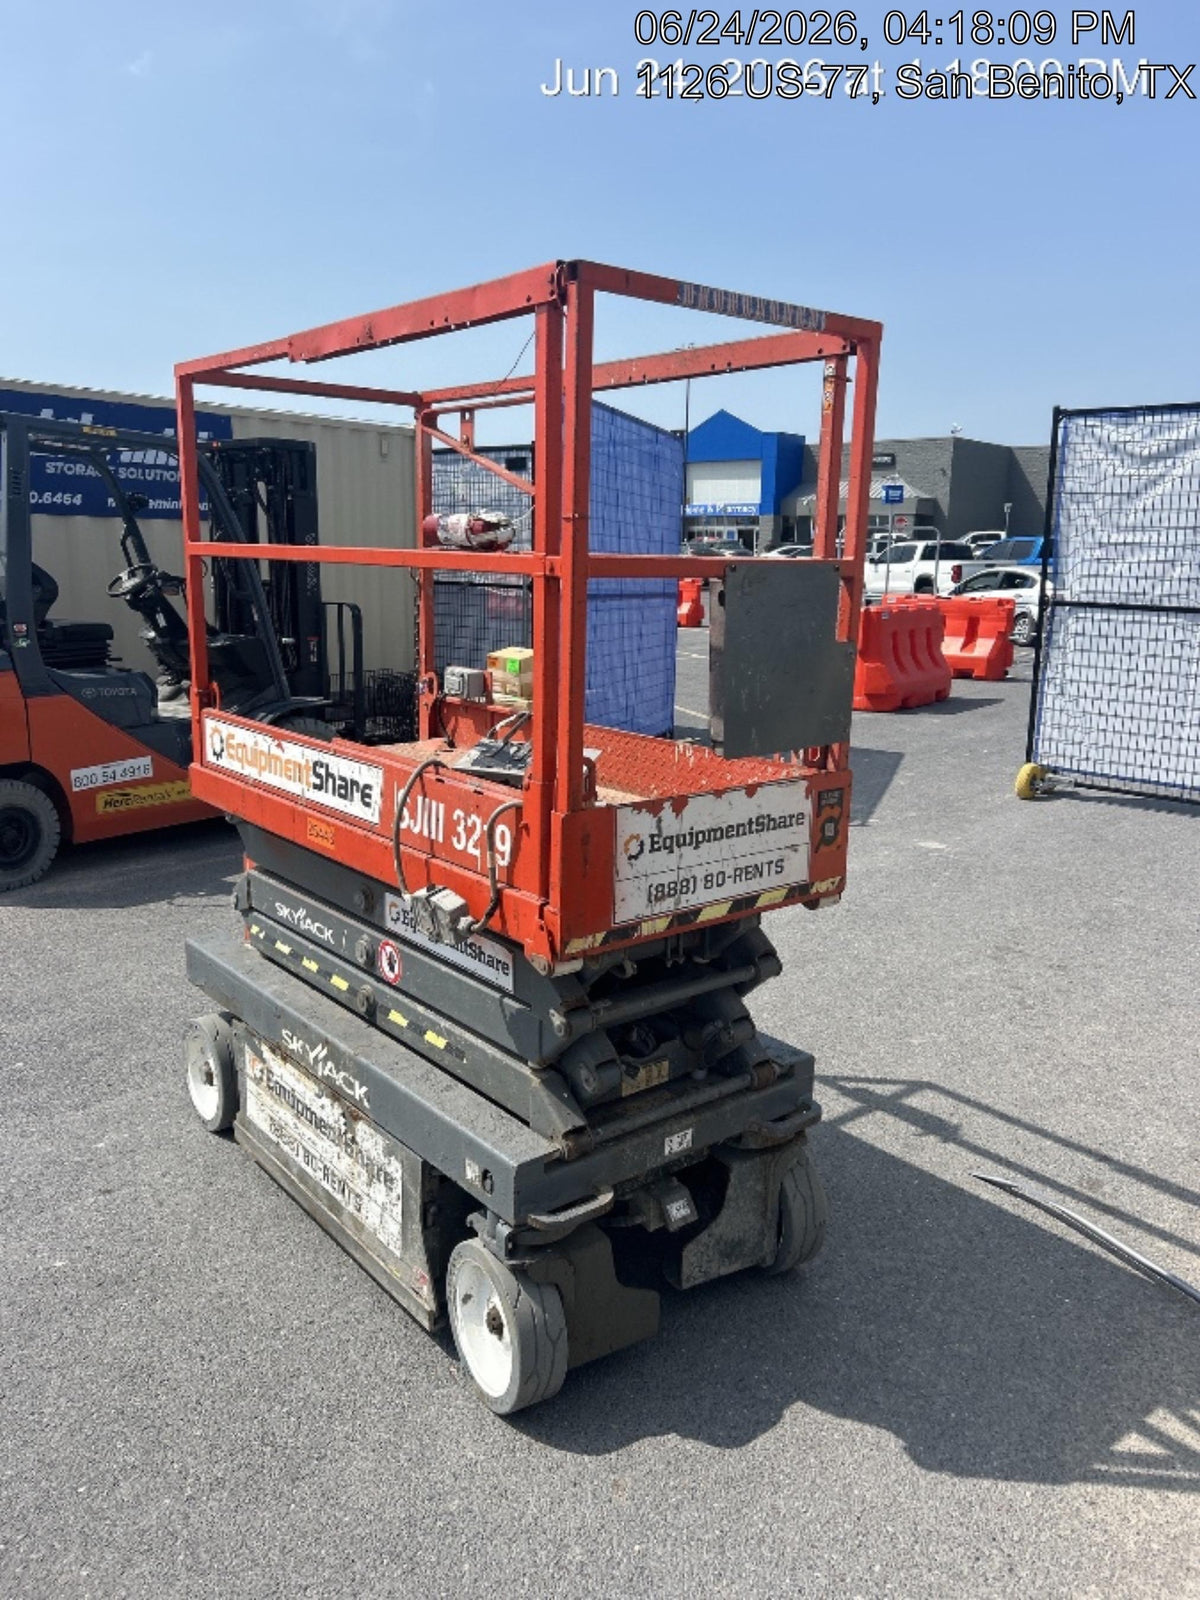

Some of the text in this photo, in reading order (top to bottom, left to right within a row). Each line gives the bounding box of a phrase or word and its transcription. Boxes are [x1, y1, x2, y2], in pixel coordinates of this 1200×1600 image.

[98, 687, 138, 697] TOYOTA
[225, 733, 374, 808] EquipmentShare
[451, 808, 512, 867] 329
[648, 811, 805, 855] EquipmentShare
[648, 858, 785, 907] (888) 80-RENTS
[274, 902, 336, 945] SKYJACK
[281, 1028, 371, 1110] SKYJACK
